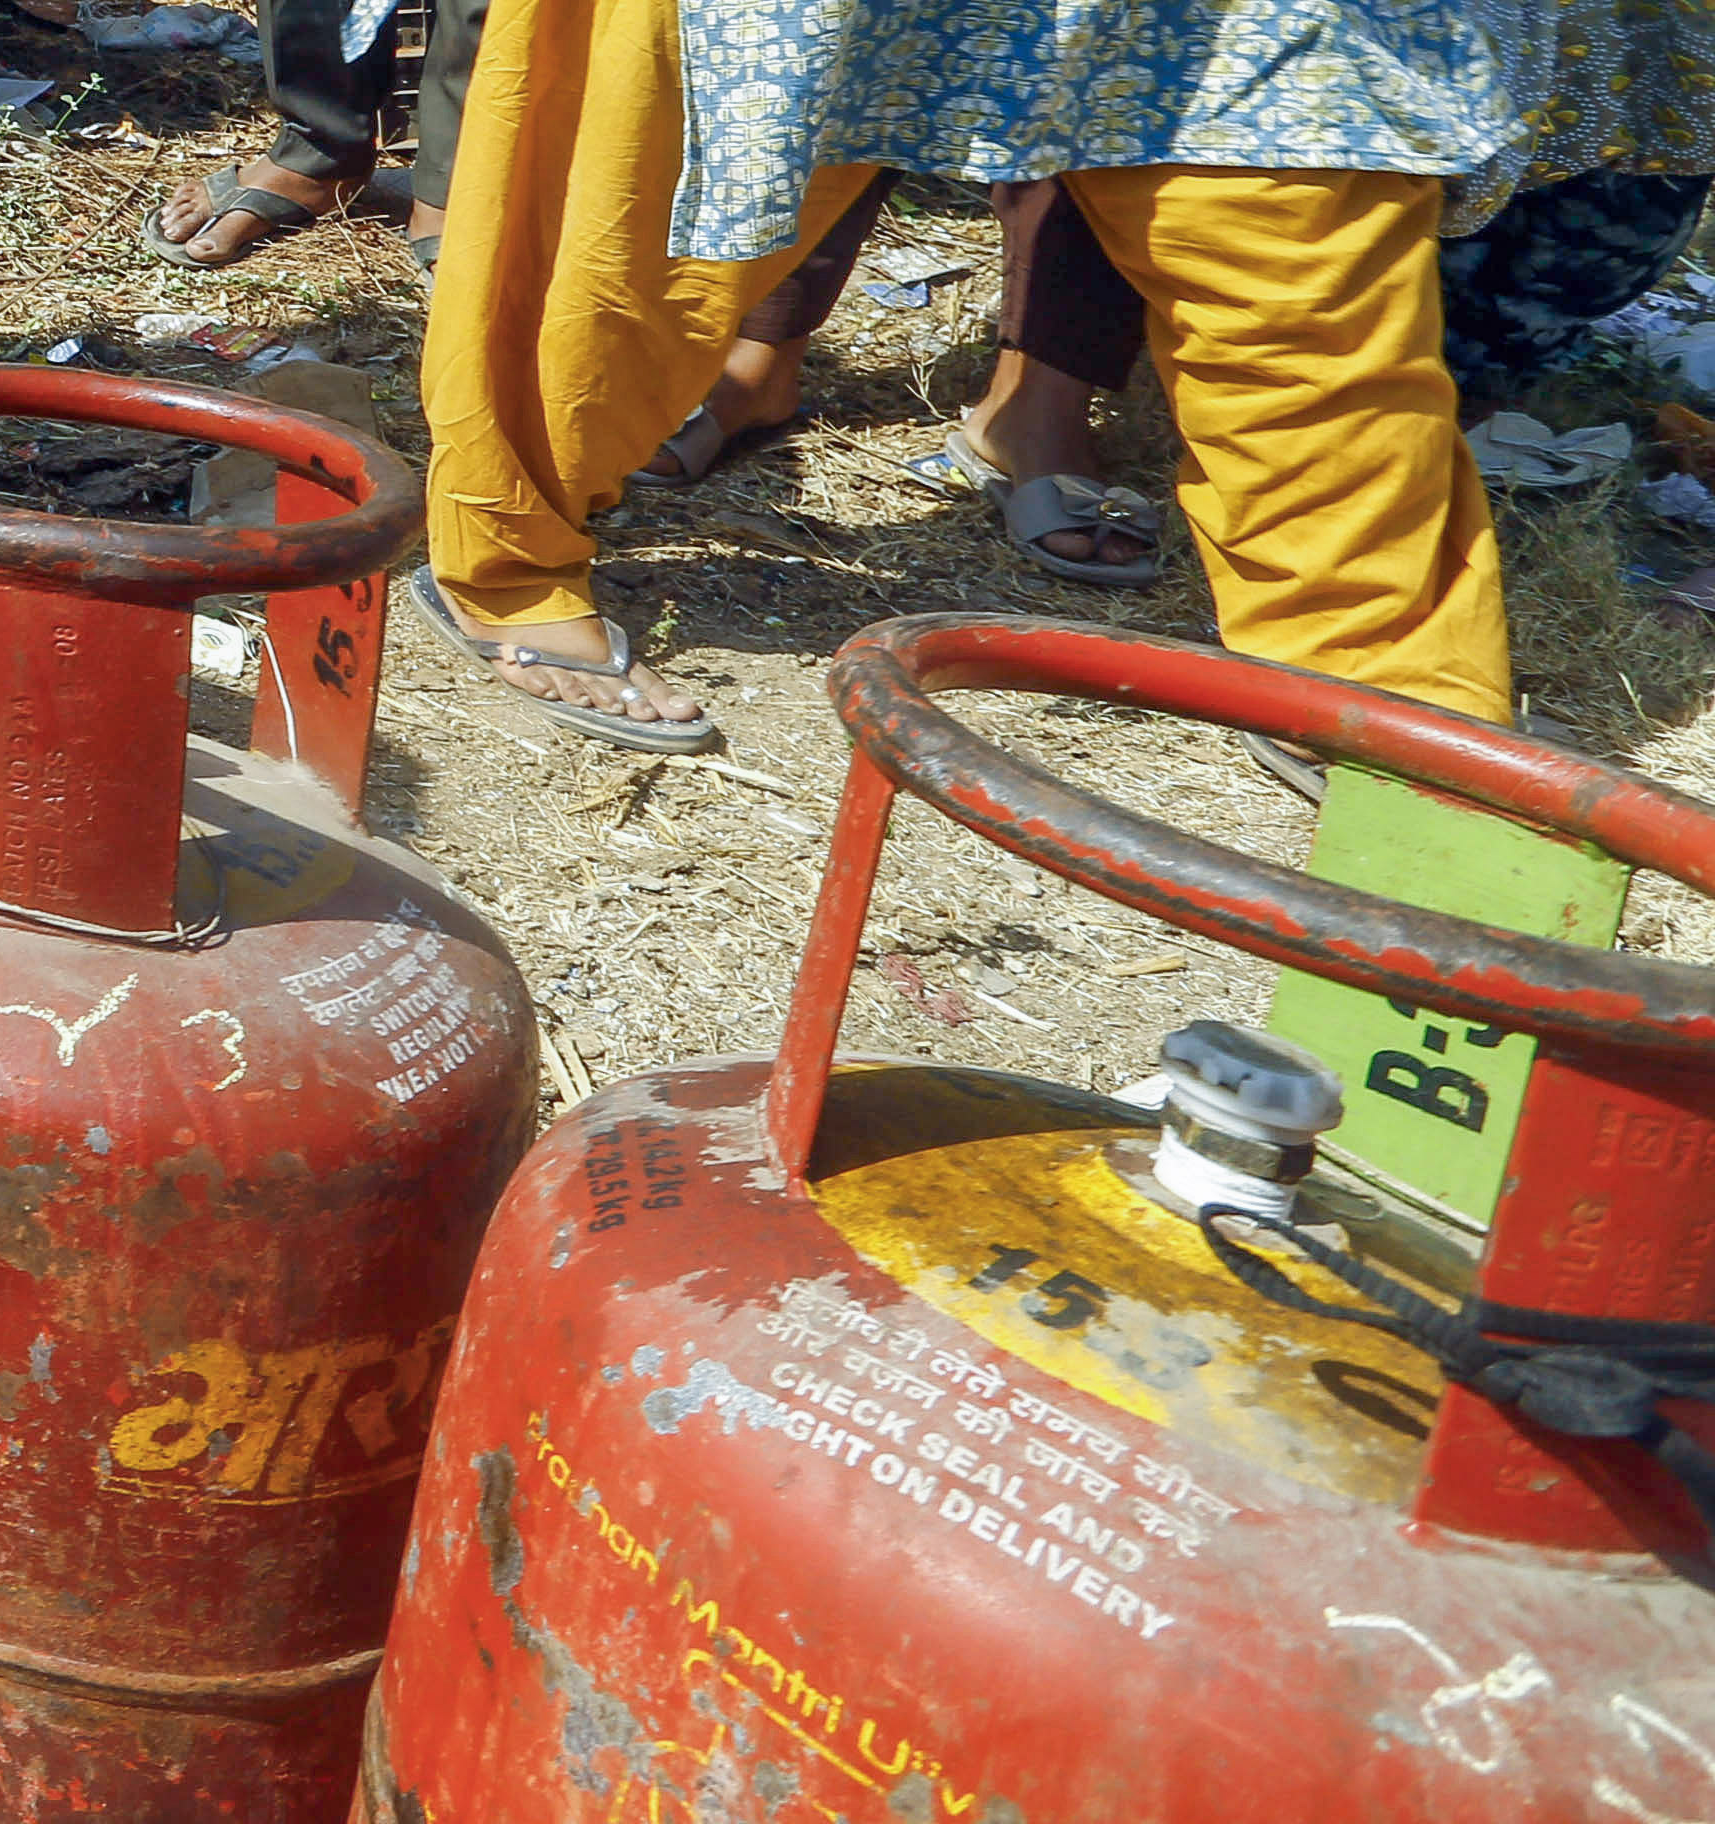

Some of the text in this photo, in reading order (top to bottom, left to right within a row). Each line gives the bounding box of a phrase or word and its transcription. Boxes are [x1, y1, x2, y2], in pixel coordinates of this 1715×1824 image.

[369, 985, 438, 1038] SWITCH
[770, 1361, 1147, 1574] CHECK SEAL AND
[930, 1348, 1007, 1400] लेते
[1009, 1387, 1131, 1465] समय
[954, 1399, 1014, 1444] की
[870, 1451, 940, 1506] ON
[939, 1488, 1175, 1641] DELIVERY
[670, 1579, 845, 1734] Mantri
